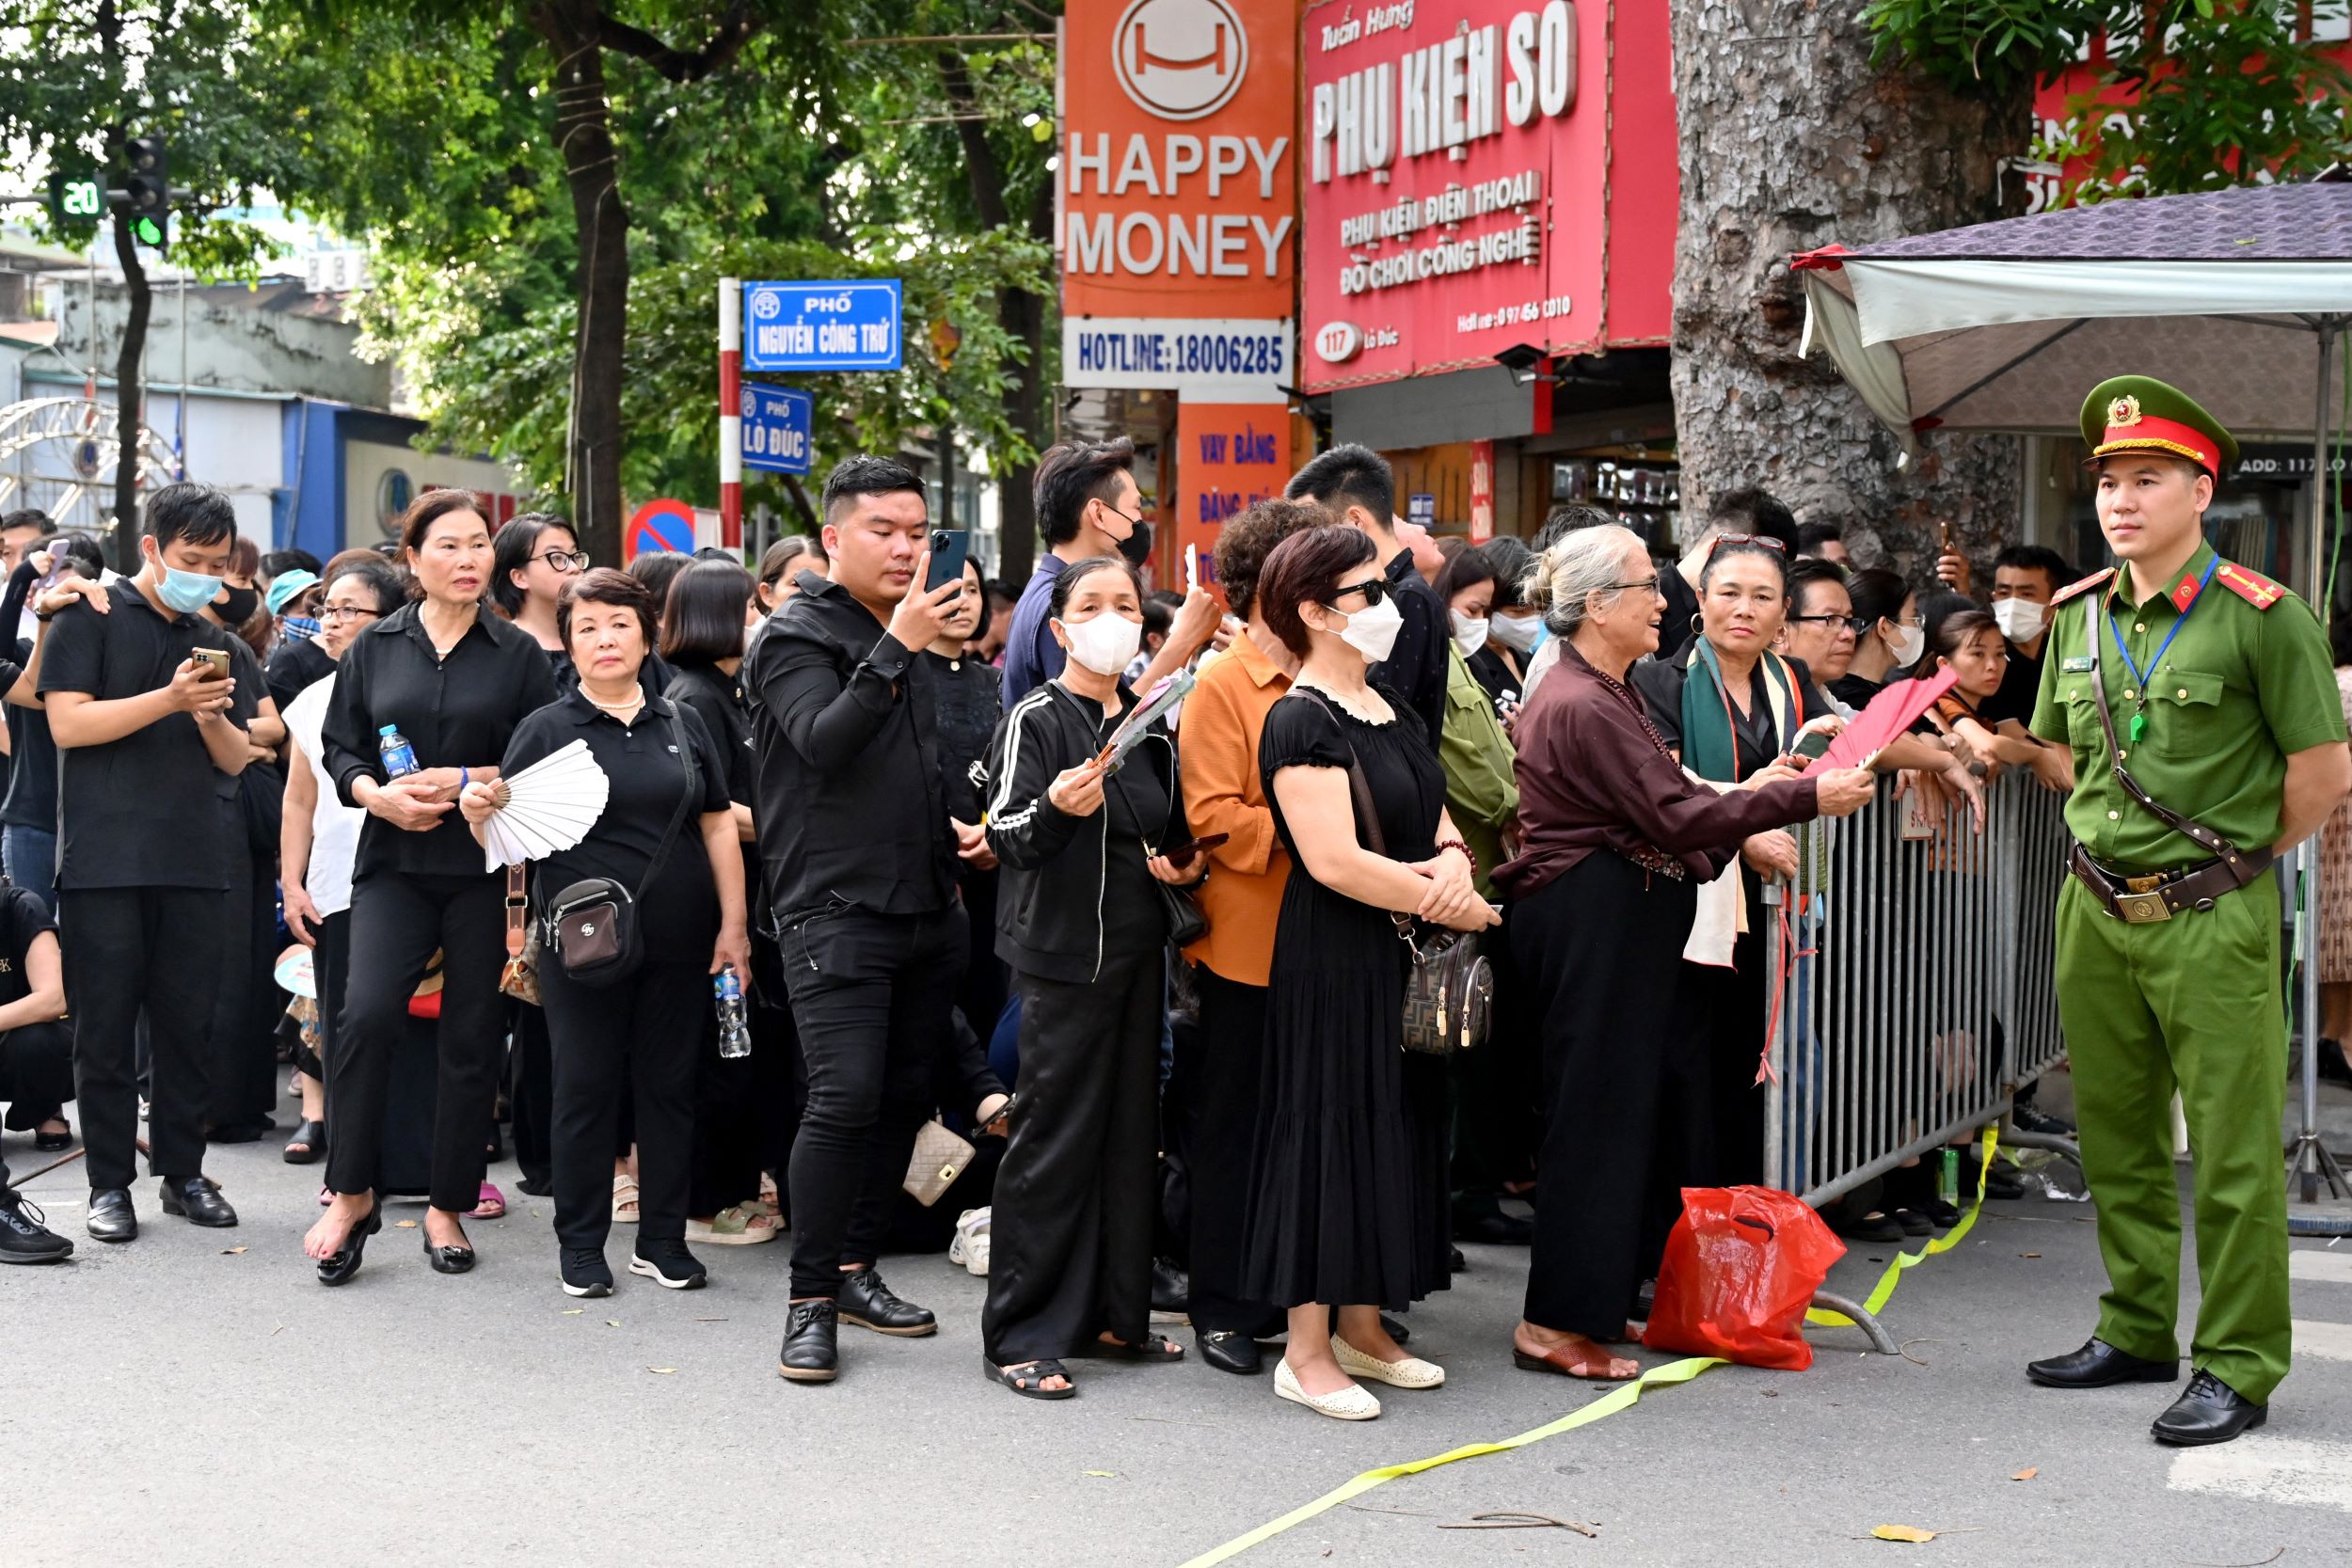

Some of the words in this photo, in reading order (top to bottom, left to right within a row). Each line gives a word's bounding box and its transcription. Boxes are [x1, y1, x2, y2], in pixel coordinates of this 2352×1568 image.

[1312, 62, 1394, 183] PHỤ
[1402, 19, 1501, 162] KIỆN
[1070, 132, 1289, 198] HAPPY
[64, 182, 99, 214] 20
[1341, 214, 1379, 249] PHỤ
[1380, 196, 1422, 242] KIỆN
[1424, 182, 1471, 230] ĐIỆN
[1473, 170, 1540, 214] THOẠI
[1067, 212, 1294, 277] MONEY
[1340, 253, 1369, 295] ĐỒ
[1370, 248, 1416, 289] CHƠI
[1418, 235, 1478, 277] CÔNG
[1478, 215, 1540, 265] NGHỆ
[804, 291, 853, 312] PHỐ
[758, 315, 814, 354] NGUYỄN
[818, 318, 857, 354] CÔNG
[861, 317, 890, 354] TRỨ
[1325, 330, 1345, 354] 117
[1363, 327, 1376, 350] Lò
[766, 399, 791, 418] PHỐ
[744, 418, 766, 453] LÒ
[769, 423, 804, 459] ĐÚC
[1200, 435, 1228, 465] VAY
[2239, 458, 2281, 472] ADD:
